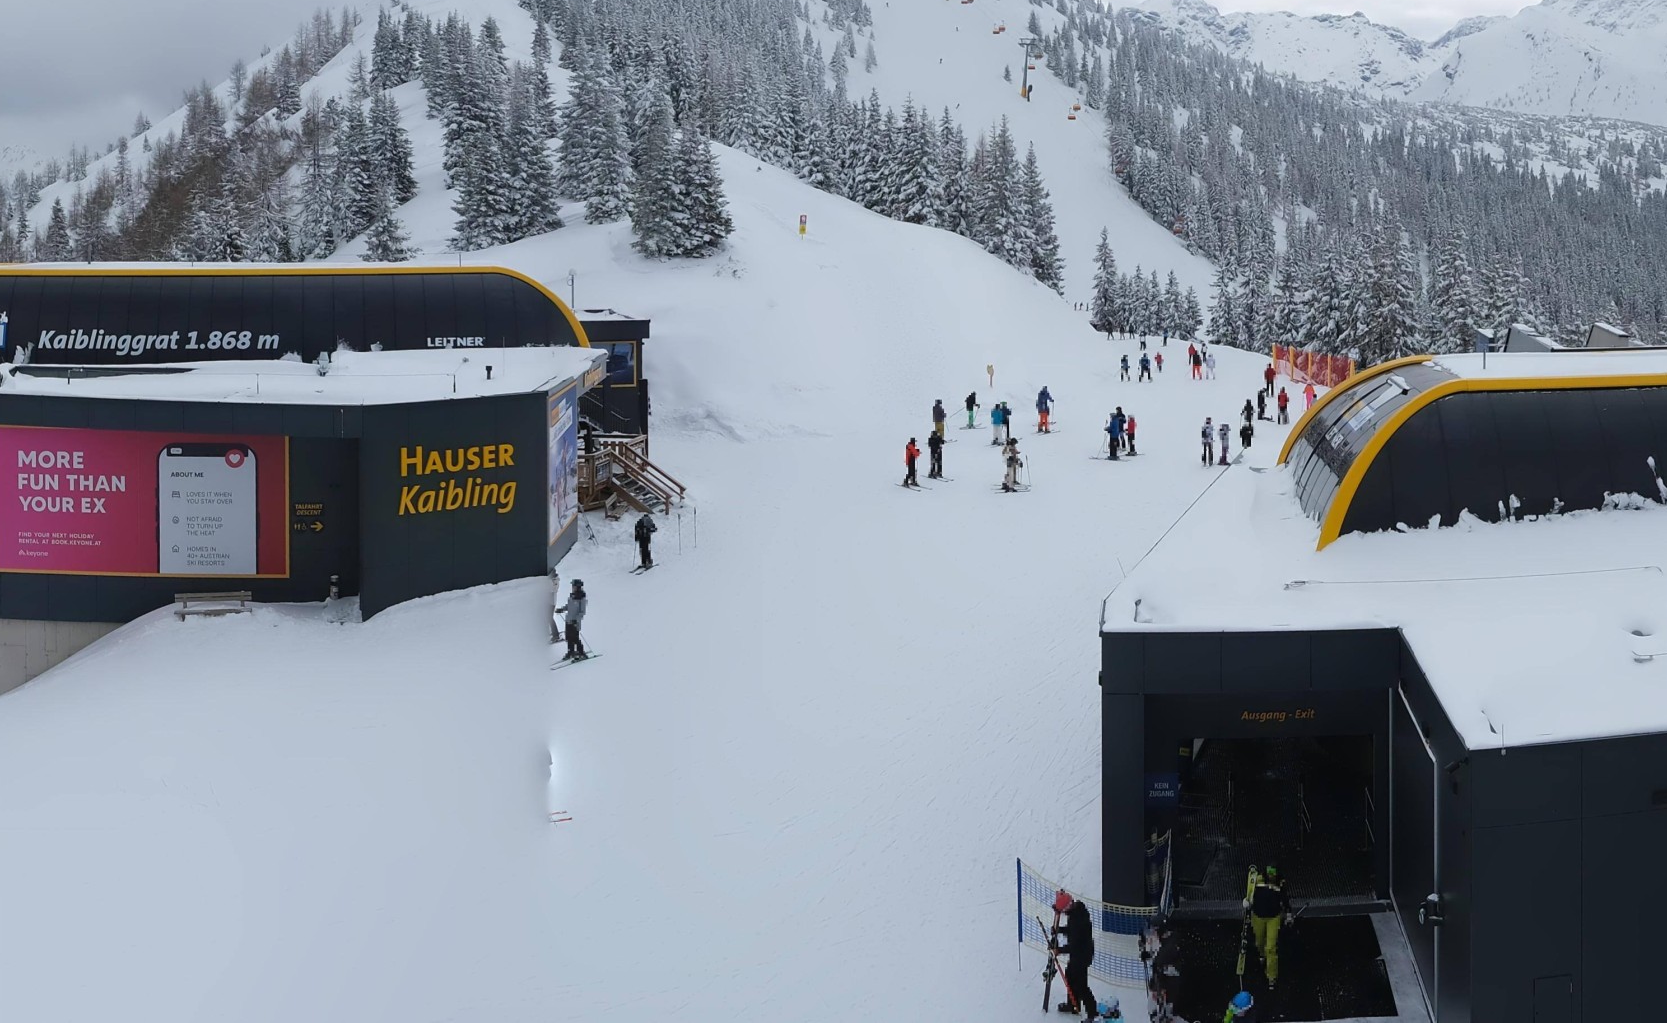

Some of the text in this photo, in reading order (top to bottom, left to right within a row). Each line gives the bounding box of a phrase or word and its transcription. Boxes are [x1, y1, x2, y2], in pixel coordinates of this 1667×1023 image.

[38, 328, 280, 356] Kaiblinggrat 1.868 m
[427, 337, 484, 347] LEITNER
[17, 450, 84, 468] MORE
[400, 443, 515, 477] HAUSER
[18, 473, 126, 492] FUN THAN
[19, 496, 106, 513] YOUR EX
[398, 477, 517, 516] Kaibling
[1240, 709, 1286, 722] Ausgang
[1295, 708, 1316, 719] Exit
